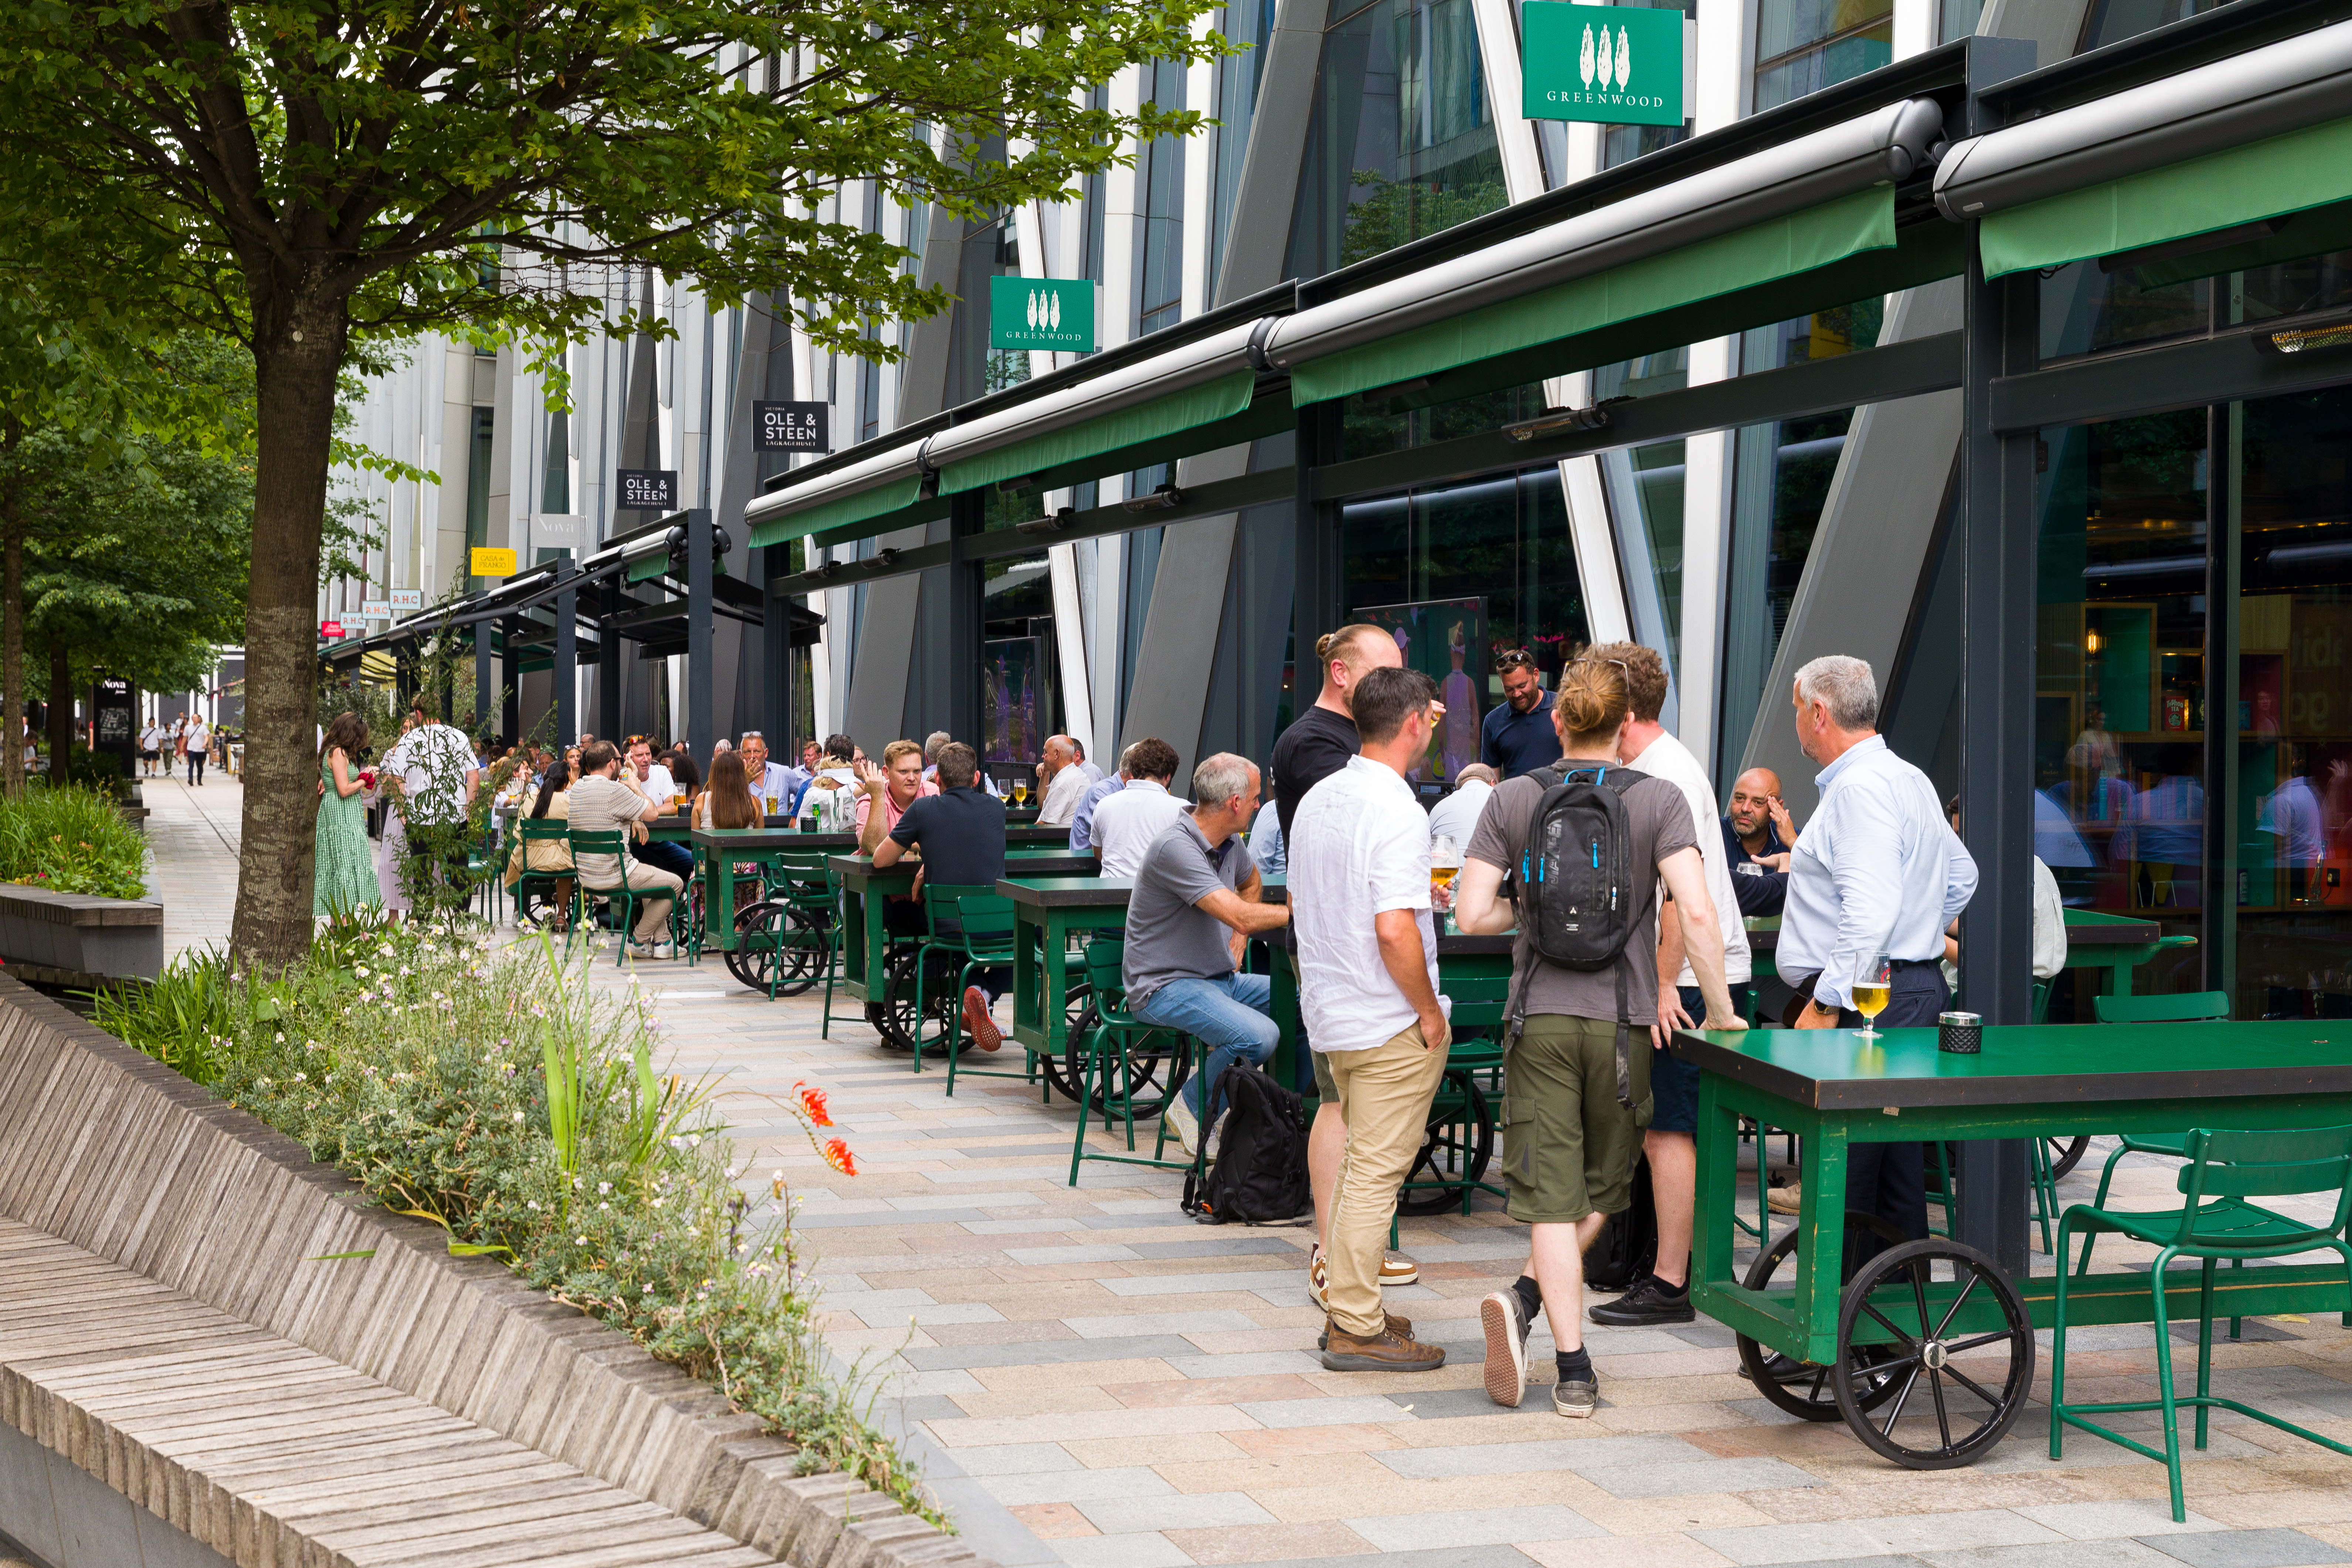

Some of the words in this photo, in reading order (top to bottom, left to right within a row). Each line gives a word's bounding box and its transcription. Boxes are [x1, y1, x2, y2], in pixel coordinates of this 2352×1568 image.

[1547, 91, 1663, 107] GREENWOOD
[1006, 331, 1081, 341] GREENWOOD
[765, 412, 795, 425] OLE
[806, 413, 816, 426] &
[766, 426, 816, 439] STEEN
[626, 479, 650, 489] OLE
[659, 480, 667, 490] &
[627, 490, 667, 500] STEEN
